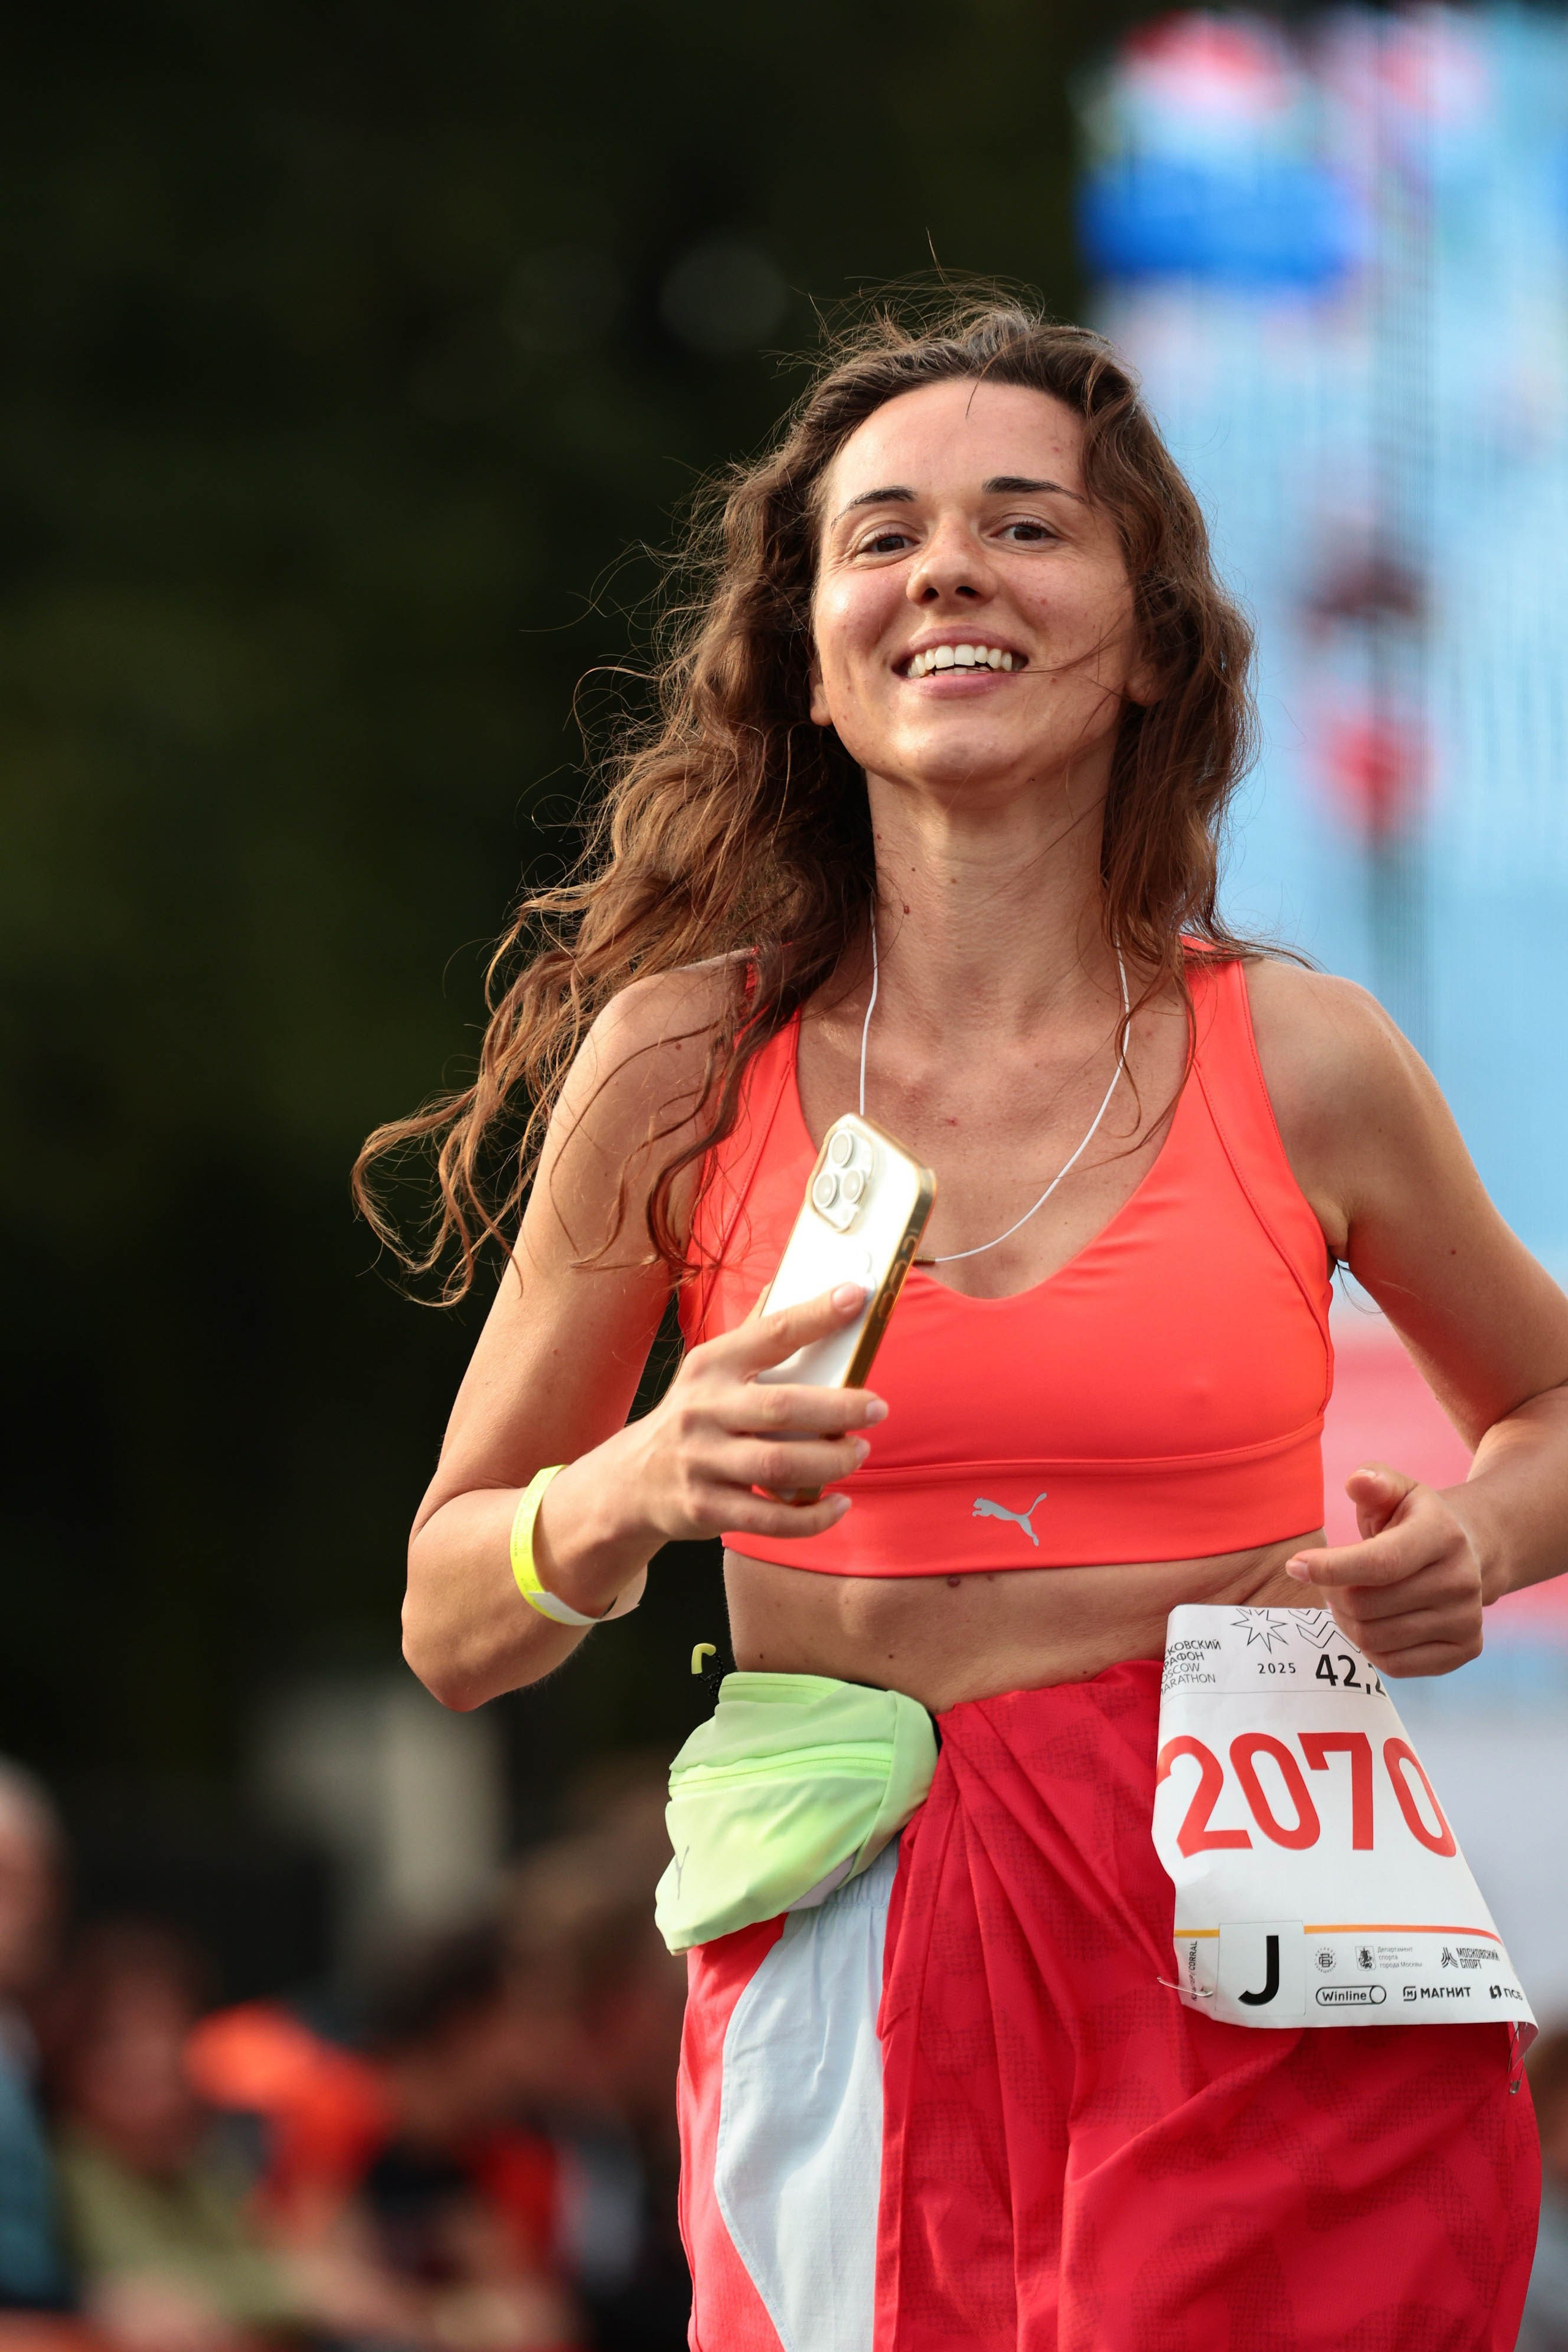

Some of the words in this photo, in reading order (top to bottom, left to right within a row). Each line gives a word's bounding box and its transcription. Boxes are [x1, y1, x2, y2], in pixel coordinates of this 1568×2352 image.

[1163, 1651, 1205, 1672] РАФОН
[1257, 1662, 1296, 1675] 2025
[1161, 1663, 1200, 1684] OSCOW
[1156, 1732, 1457, 1858] 2070
[1188, 1940, 1197, 1970] CORRAL
[1456, 1948, 1500, 1961] МОСКОВСКИЙ
[1238, 1935, 1280, 2006] J
[1460, 1959, 1482, 1969] СПОРТ
[1322, 1991, 1367, 2002] Winline
[1420, 1987, 1471, 1999] МАГНИТ
